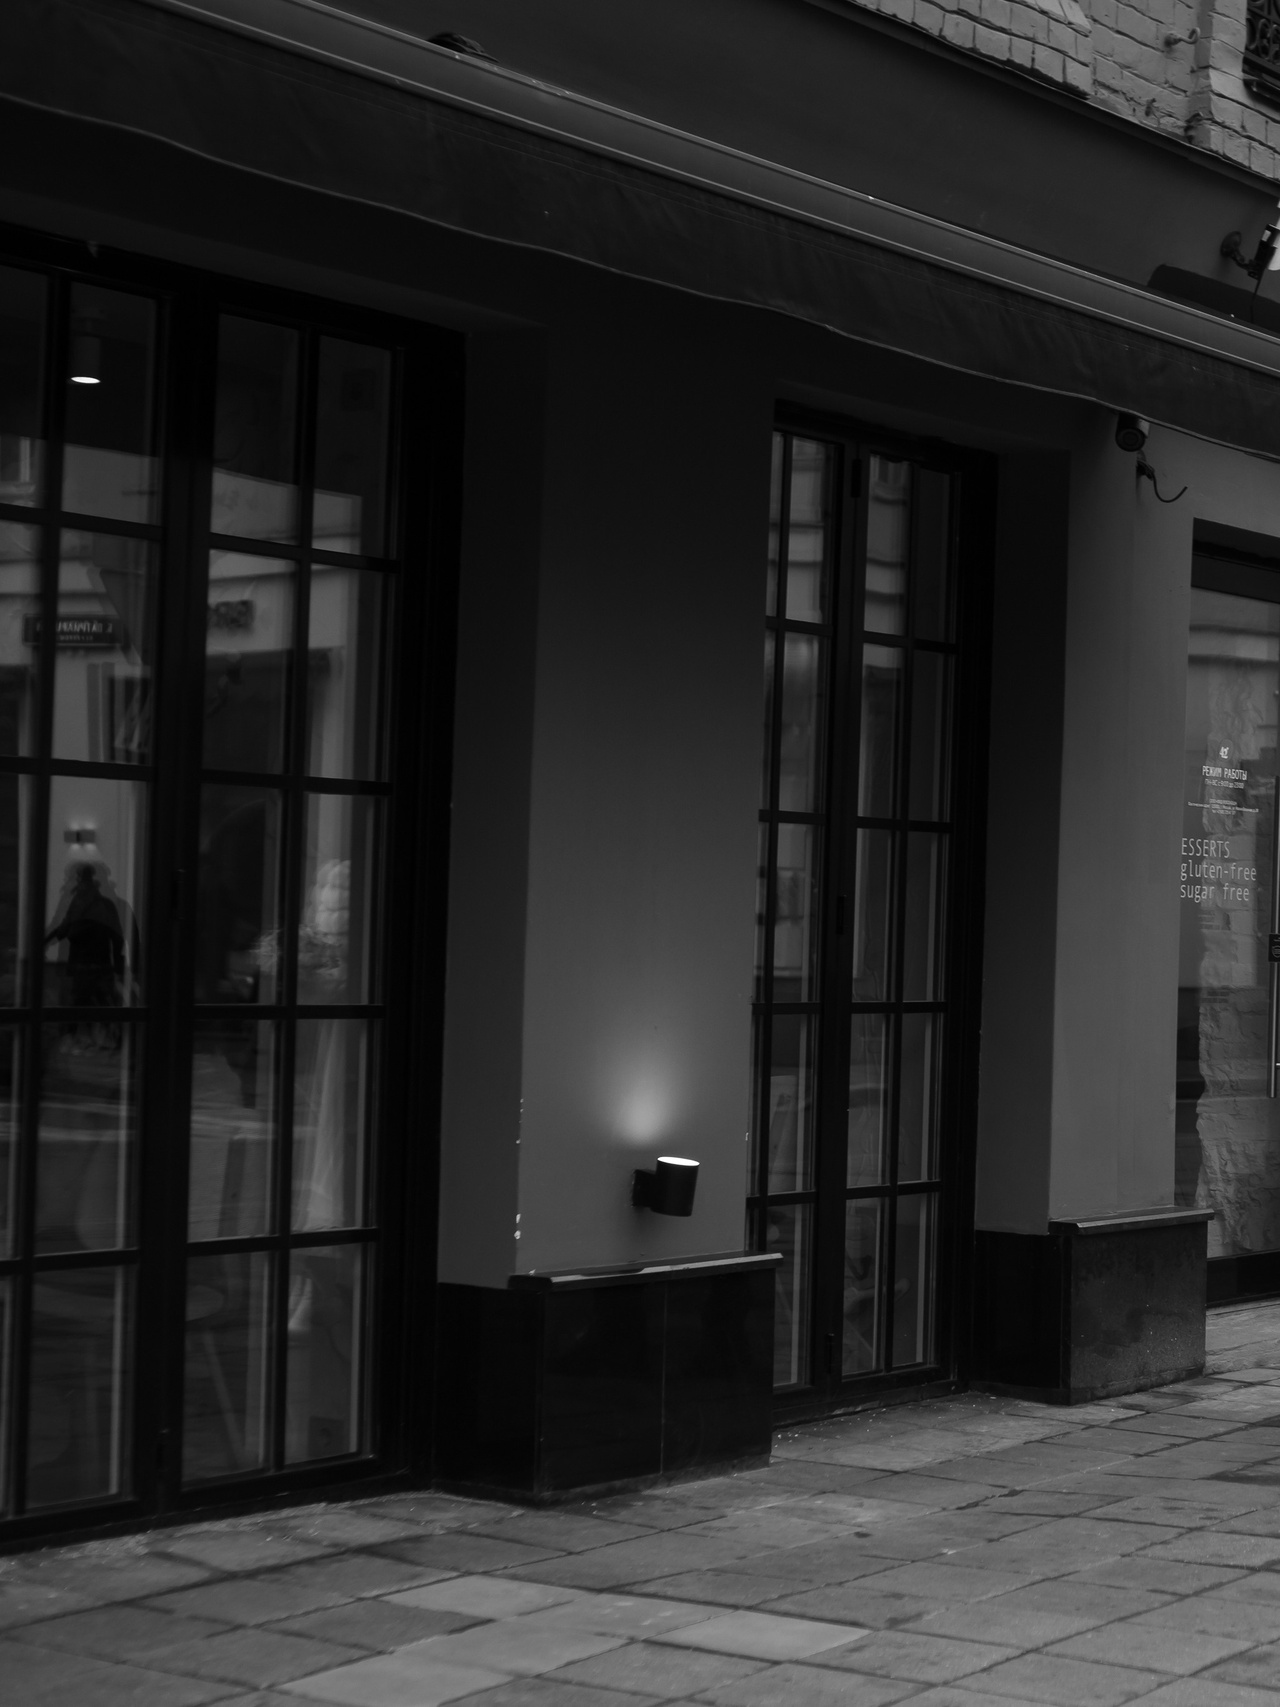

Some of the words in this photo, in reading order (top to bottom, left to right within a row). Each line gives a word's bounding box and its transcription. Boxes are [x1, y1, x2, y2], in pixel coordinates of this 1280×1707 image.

[1202, 765, 1222, 778] РЕЖИМ
[1223, 767, 1248, 781] РАБОТЫ
[1181, 837, 1230, 859] ESSERTS
[1180, 859, 1257, 881] gluten-free
[1180, 884, 1215, 903] sugar
[1223, 882, 1250, 901] free
